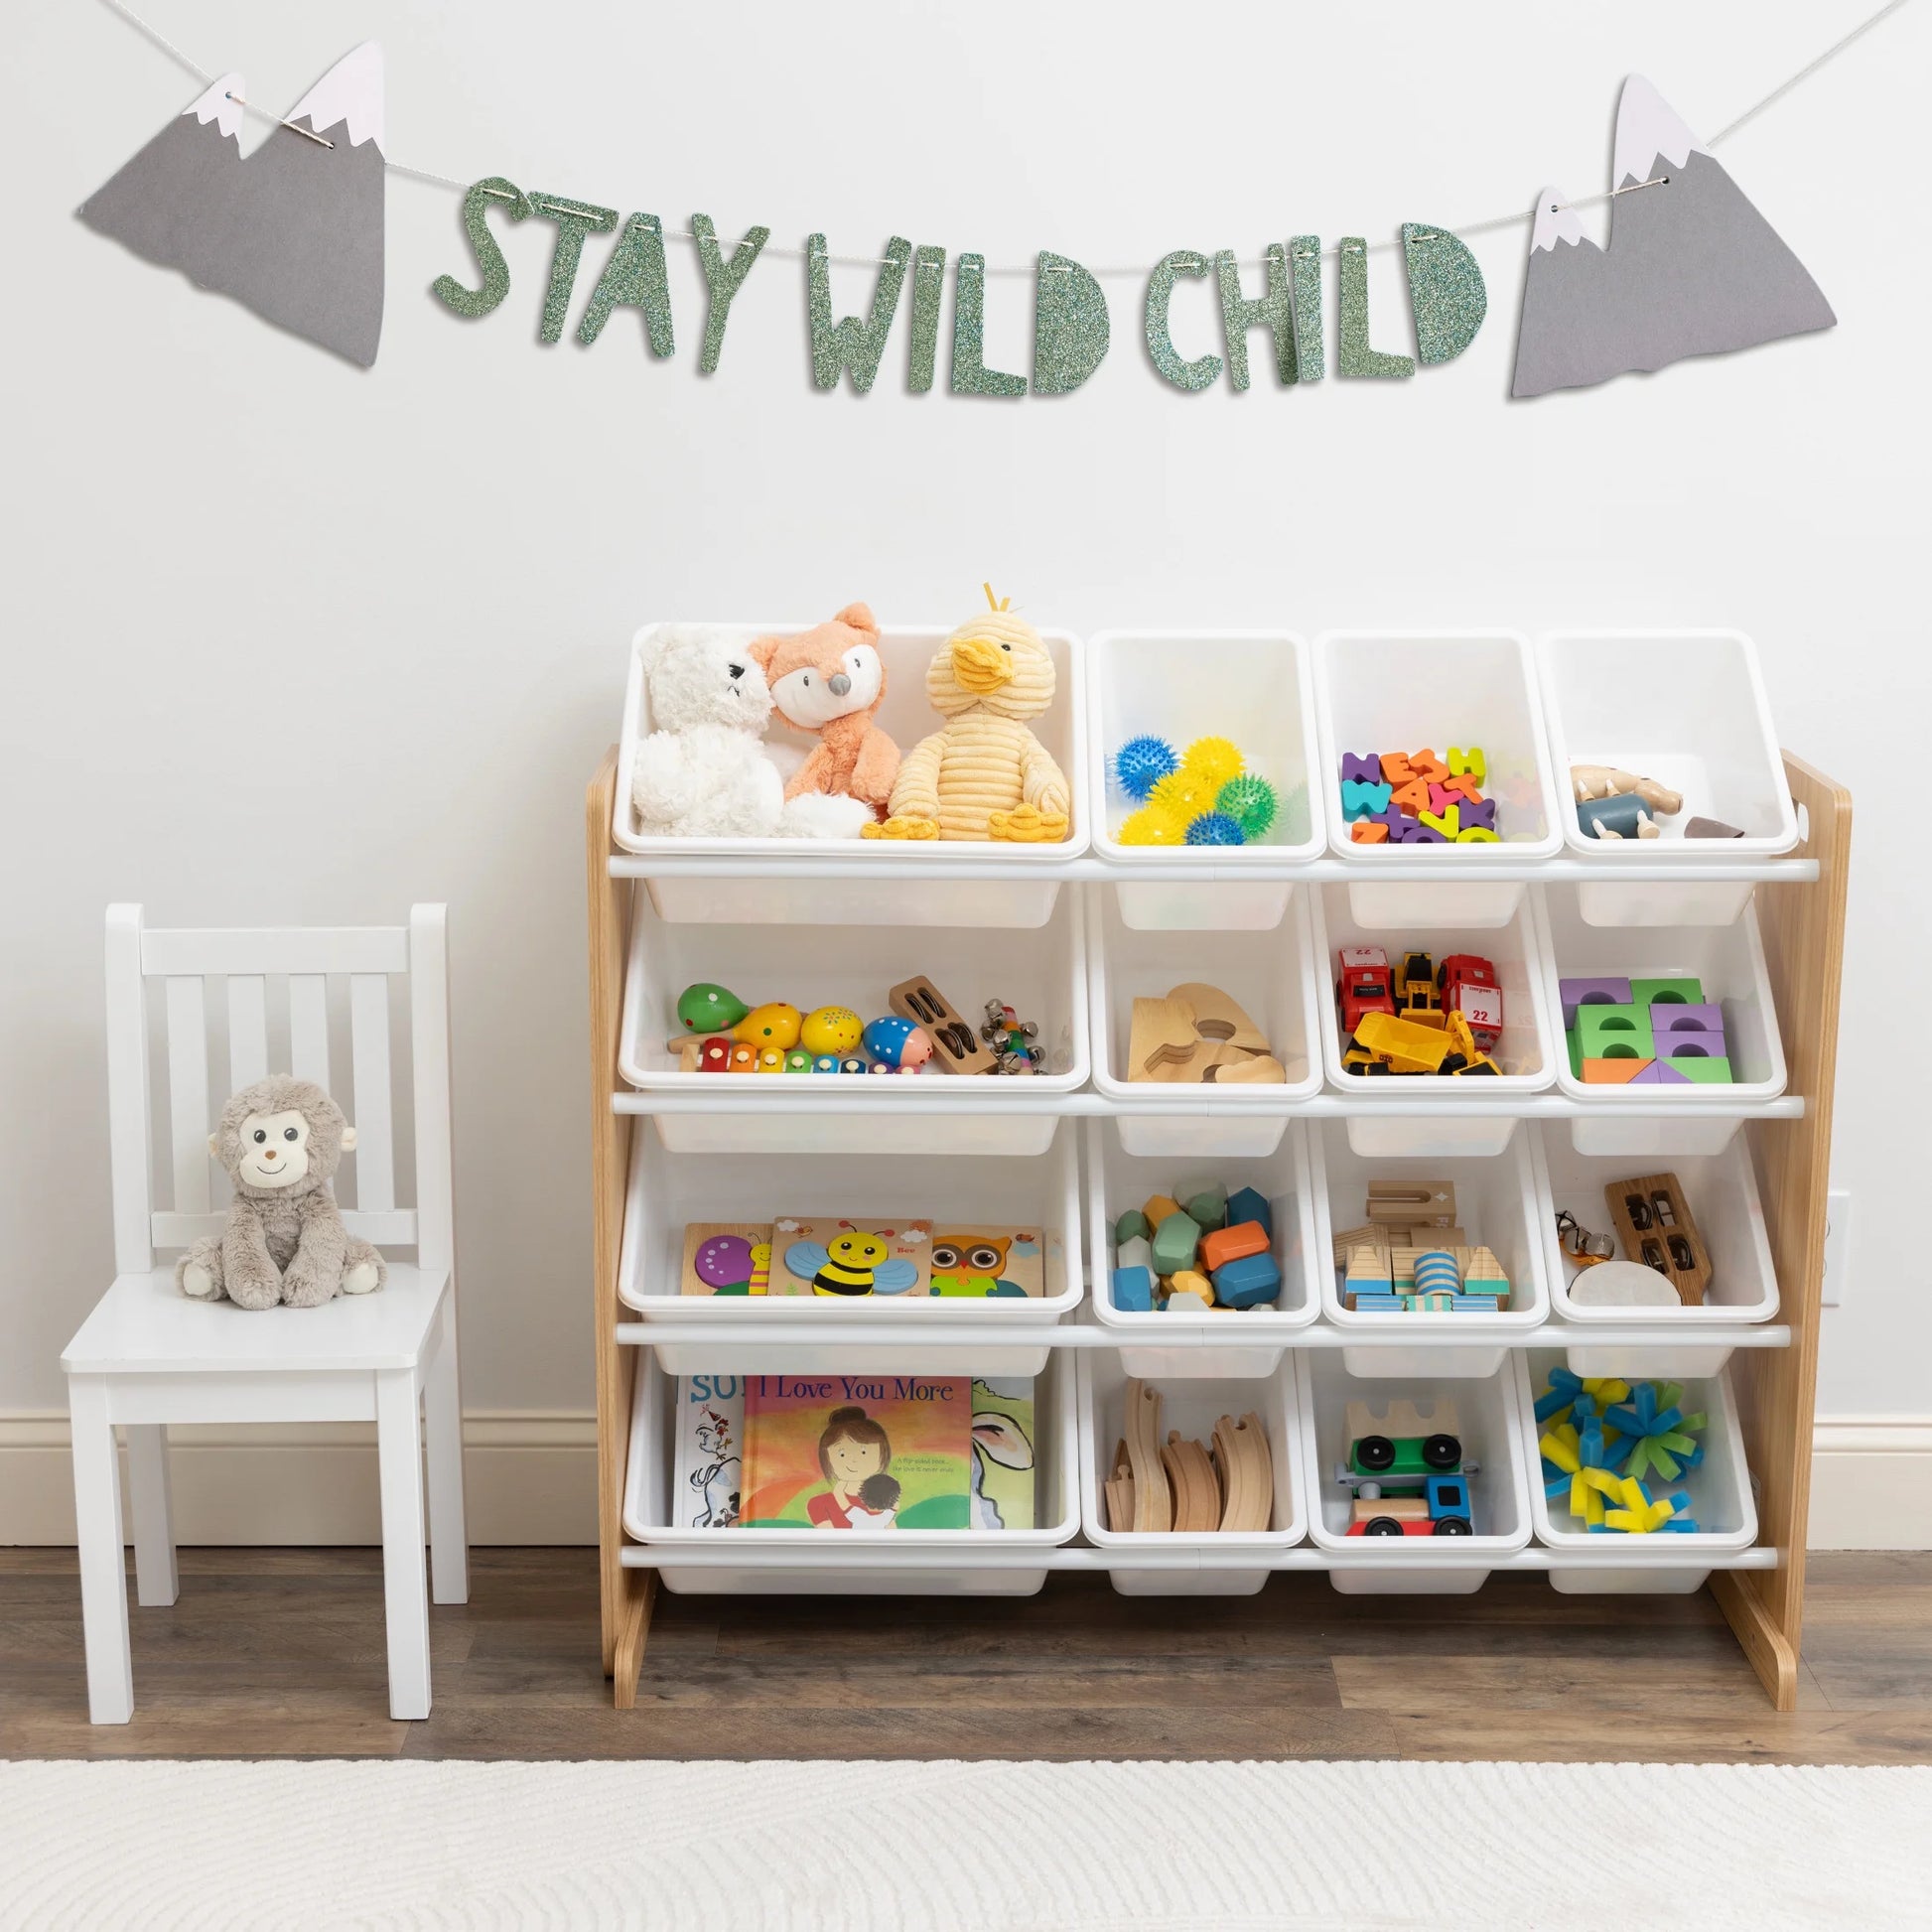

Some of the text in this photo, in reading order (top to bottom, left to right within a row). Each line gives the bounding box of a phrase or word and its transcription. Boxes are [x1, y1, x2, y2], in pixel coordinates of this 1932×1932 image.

[433, 177, 1487, 396] STAY WILD CHILD
[1448, 747, 1486, 784] H
[1472, 1010, 1488, 1022] 22
[690, 1375, 745, 1403] SO
[759, 1376, 954, 1402] I Love You More
